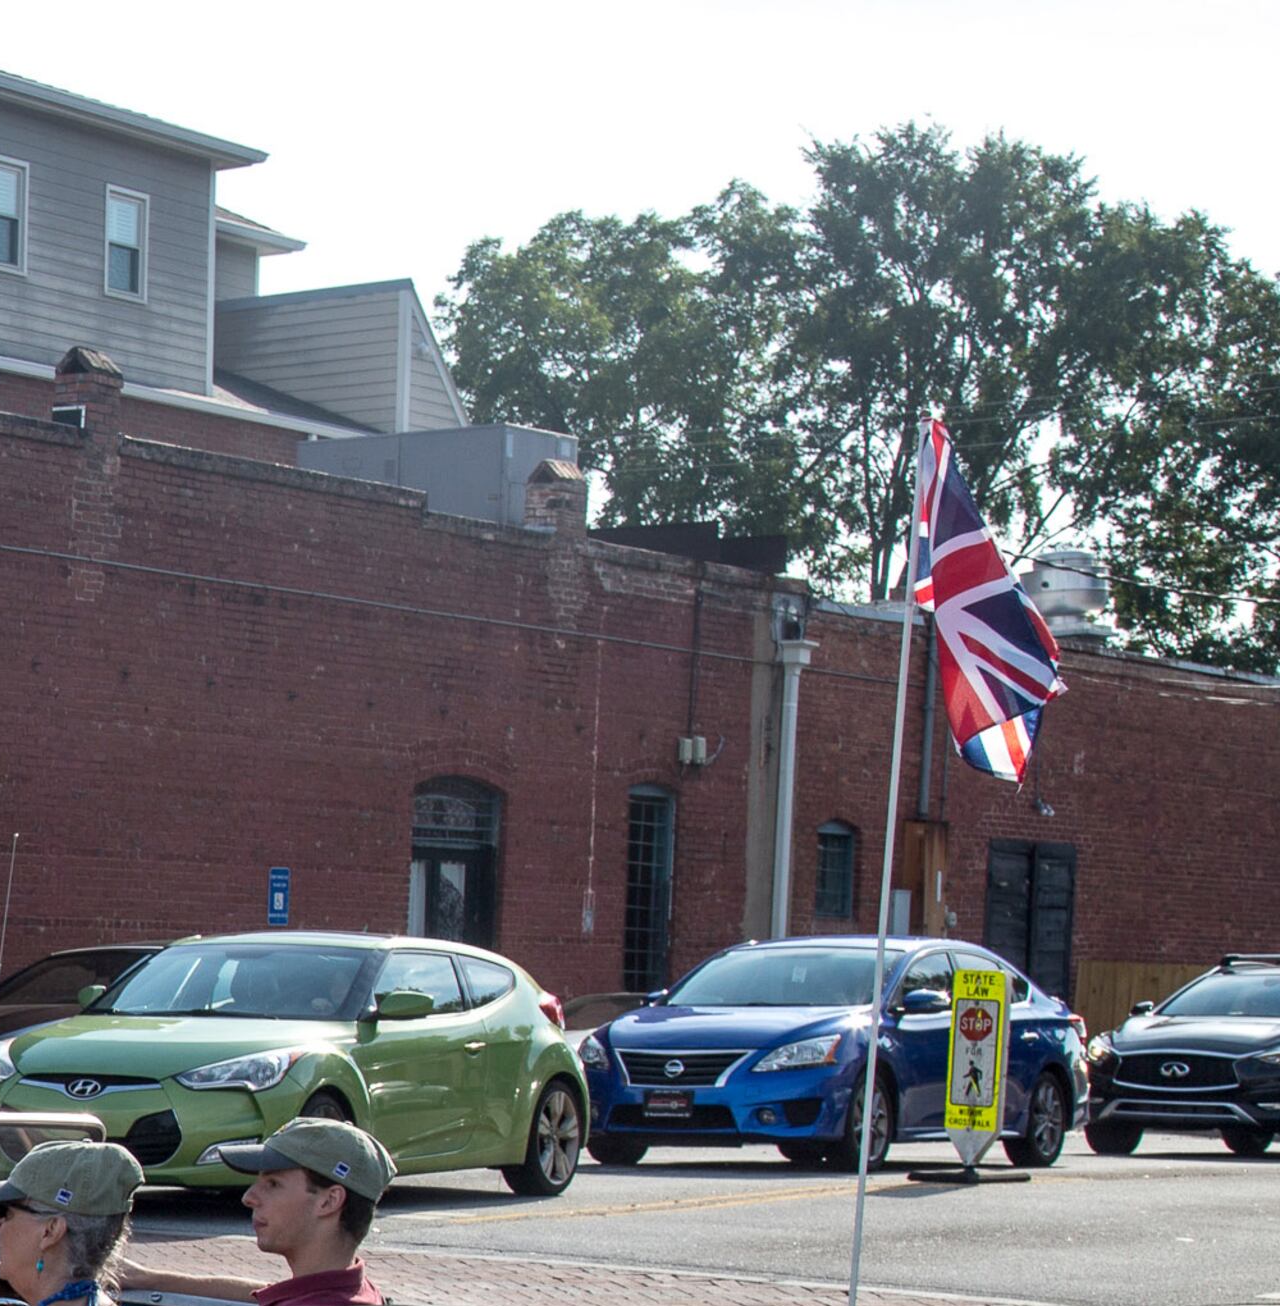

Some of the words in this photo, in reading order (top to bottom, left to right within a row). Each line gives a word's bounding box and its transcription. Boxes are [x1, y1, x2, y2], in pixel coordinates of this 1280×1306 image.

[963, 973, 996, 986] STATE
[966, 986, 989, 997] LAW
[961, 1017, 992, 1032] STOP
[965, 1046, 983, 1056] FOR
